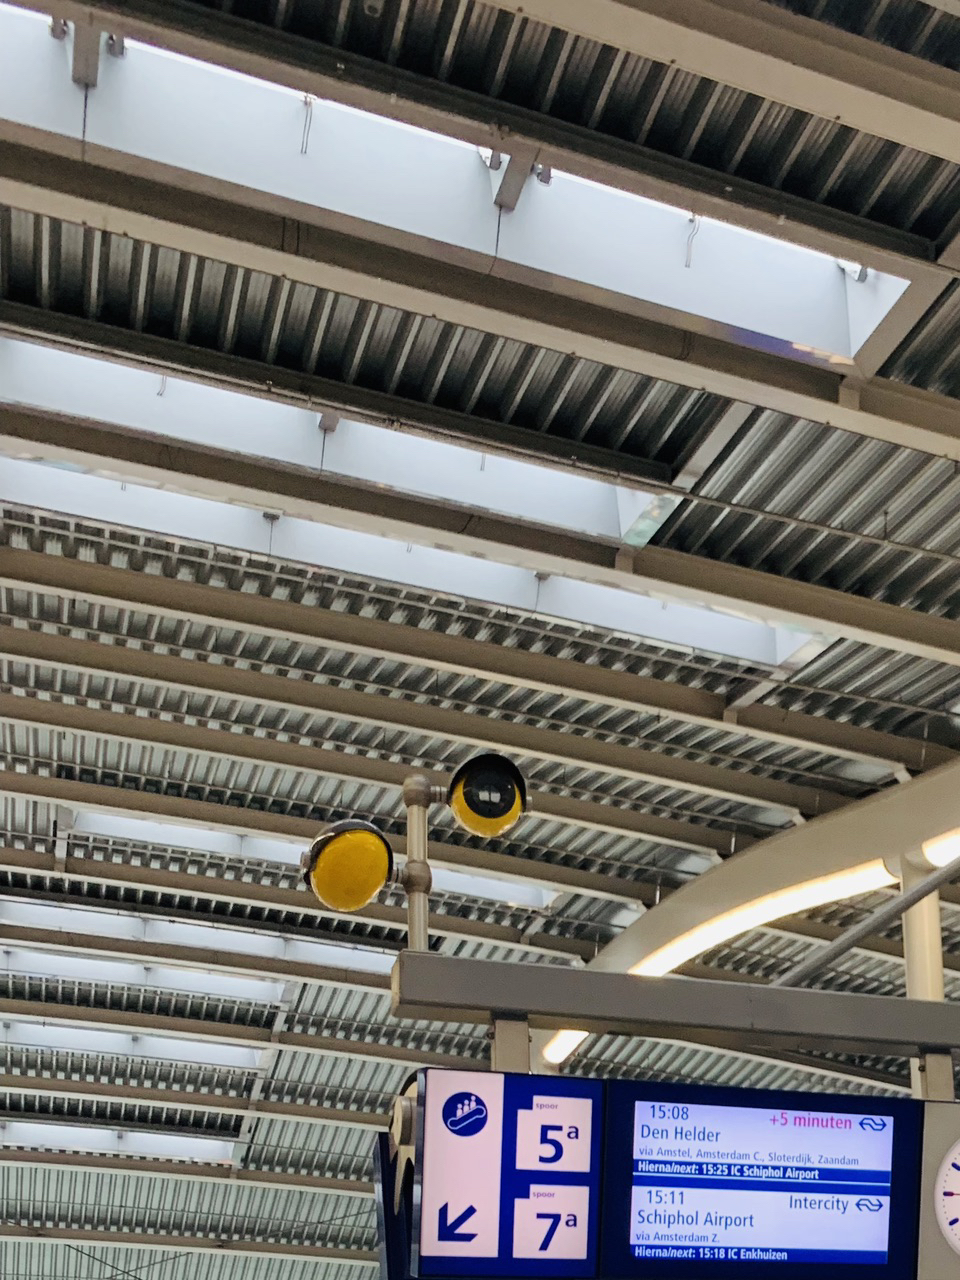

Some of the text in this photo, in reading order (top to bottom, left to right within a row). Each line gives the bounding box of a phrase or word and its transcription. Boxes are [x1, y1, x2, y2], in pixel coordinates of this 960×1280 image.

[536, 1102, 558, 1110] spoor
[650, 1104, 689, 1120] 15:08
[770, 1112, 852, 1130] +5 minuten
[641, 1124, 721, 1142] Den Helder
[639, 1146, 653, 1156] via
[656, 1147, 693, 1159] Amstel,
[696, 1148, 750, 1161] Amsterdam
[768, 1152, 814, 1165] Sloterdijk,
[818, 1154, 859, 1165] Zaandam
[702, 1163, 728, 1176] 15:25
[731, 1165, 741, 1176] IC
[743, 1165, 783, 1179] Schiphol
[785, 1167, 819, 1180] Airport
[533, 1191, 556, 1199] spoor
[647, 1190, 685, 1205] 15:11
[789, 1195, 849, 1214] Intercity
[637, 1209, 754, 1230] Schiphol Airport
[636, 1232, 720, 1243] via Amsterdam Z.
[699, 1247, 725, 1259] 15:18
[728, 1248, 738, 1259] IC
[740, 1248, 788, 1260] Enkhuizen
